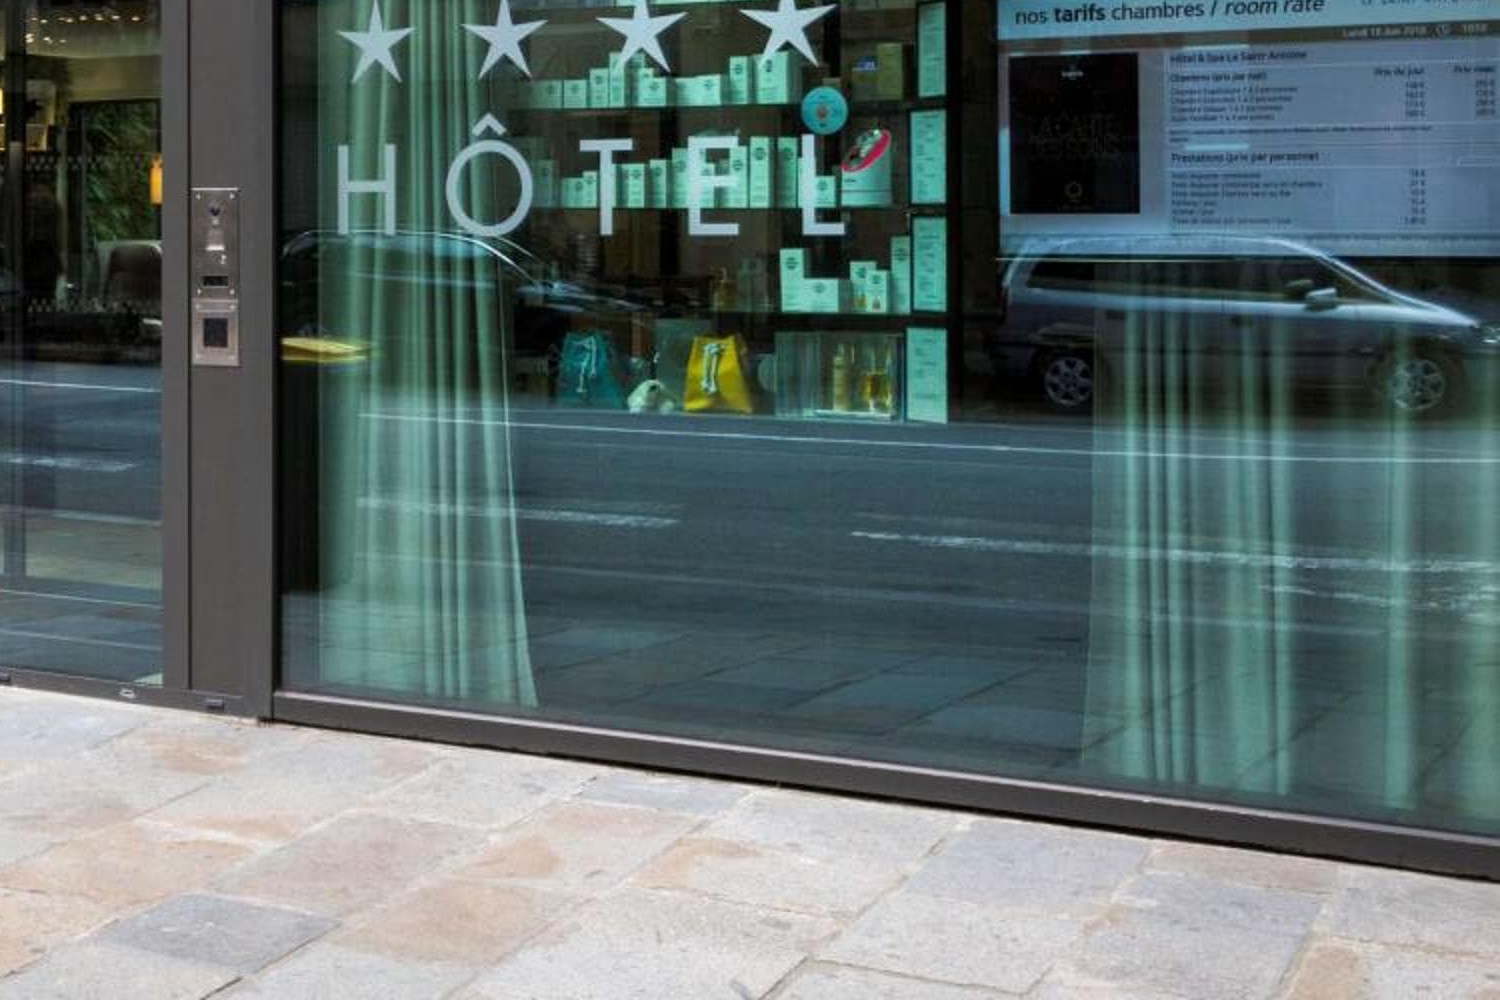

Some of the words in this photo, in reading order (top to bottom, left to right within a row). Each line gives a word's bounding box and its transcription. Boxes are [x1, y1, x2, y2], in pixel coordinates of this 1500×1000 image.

[1015, 10, 1048, 25] nos
[1054, 2, 1106, 23] tarifs
[1111, 1, 1205, 20] chambres
[1225, 0, 1278, 16] room
[337, 112, 845, 237] HÔTEL
